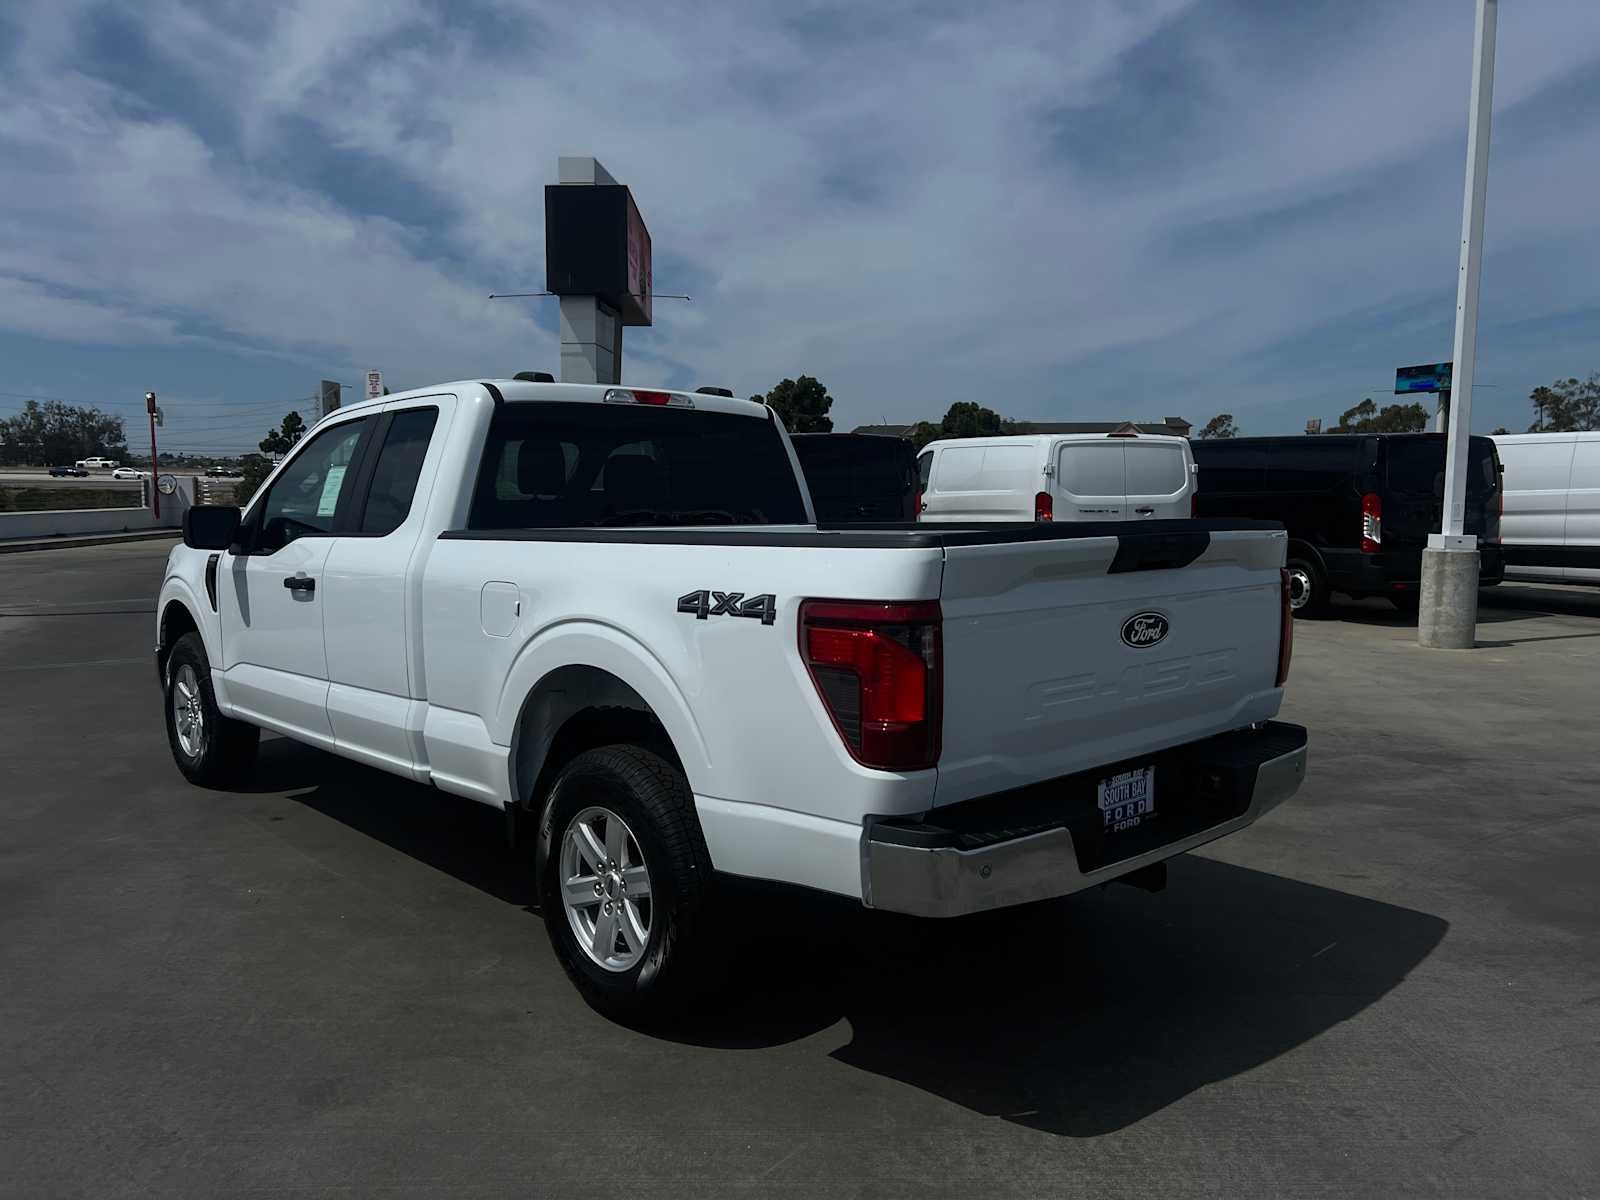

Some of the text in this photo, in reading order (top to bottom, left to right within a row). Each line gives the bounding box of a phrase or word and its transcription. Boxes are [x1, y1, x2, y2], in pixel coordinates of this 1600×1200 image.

[1131, 618, 1162, 642] Ford
[1104, 779, 1146, 805] SOUTH BAY
[1105, 800, 1145, 825] FORD
[1114, 816, 1141, 832] FORD
